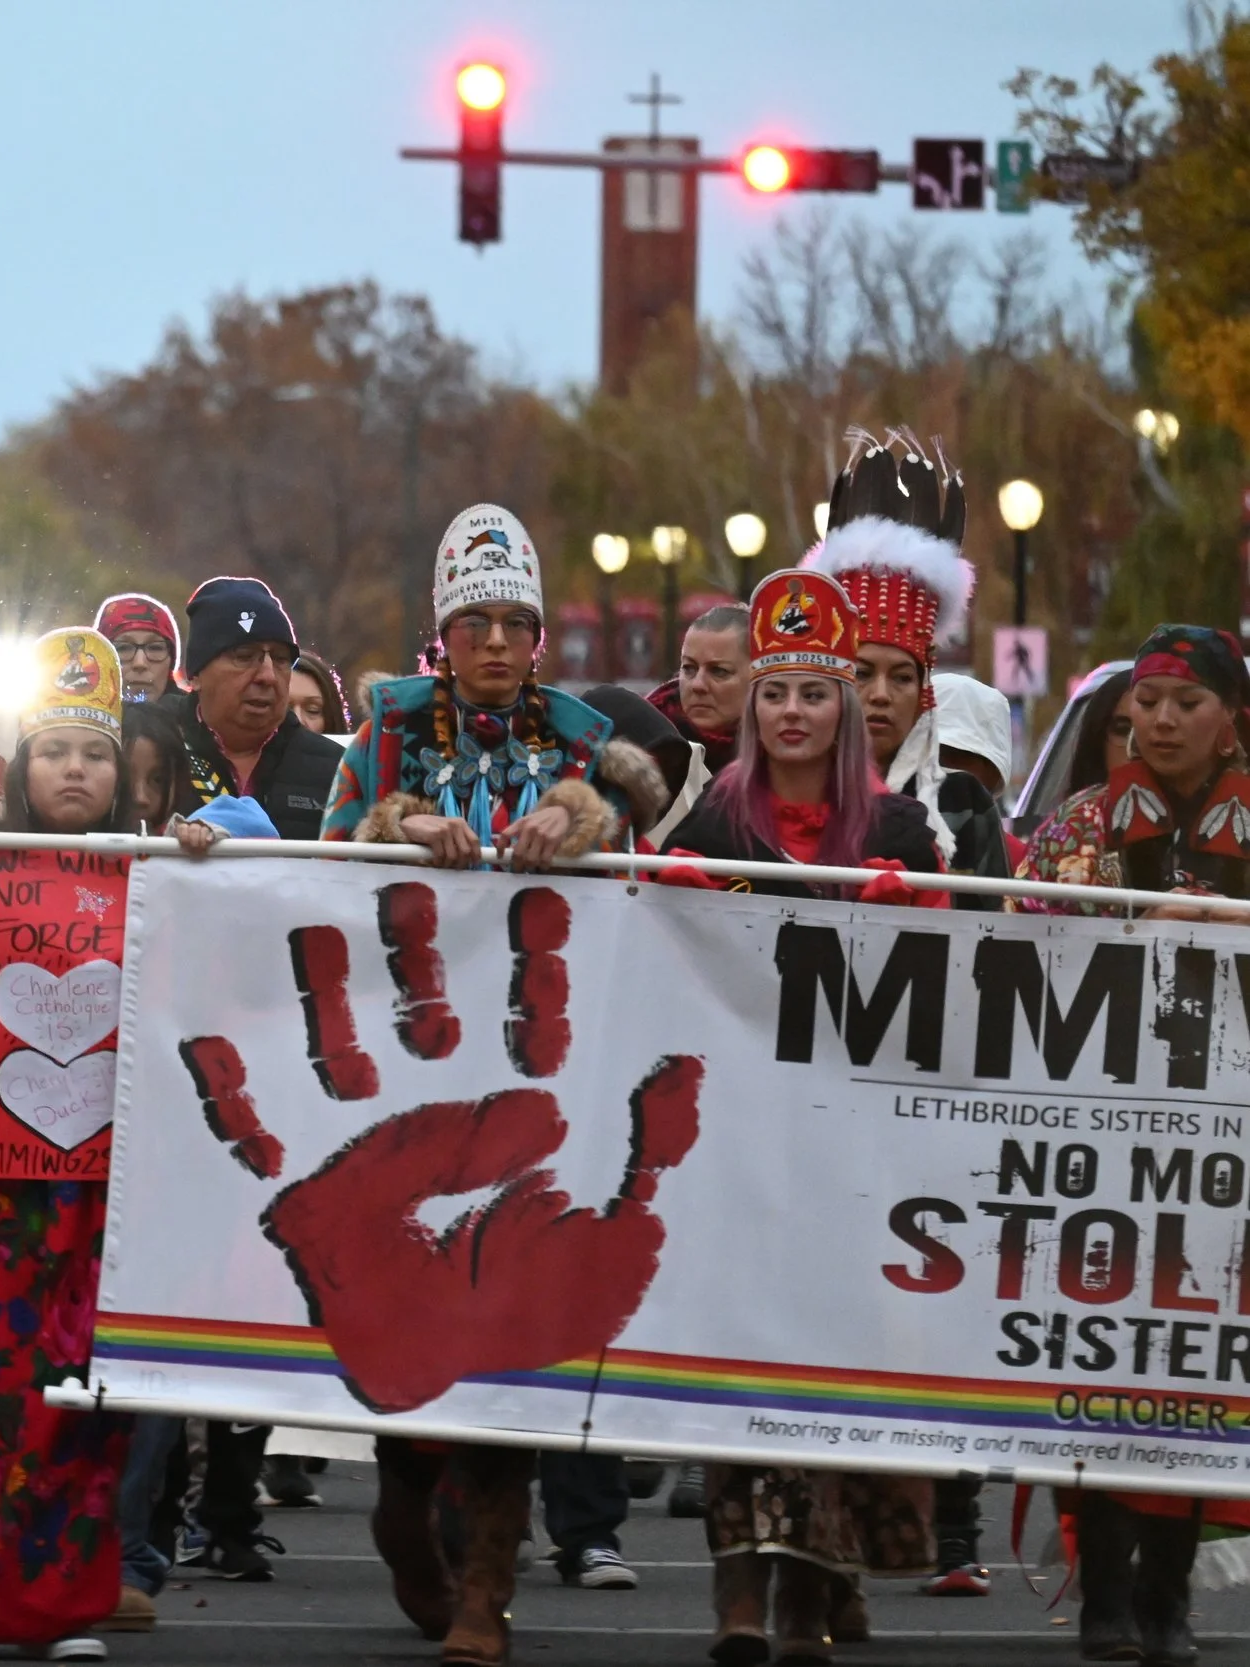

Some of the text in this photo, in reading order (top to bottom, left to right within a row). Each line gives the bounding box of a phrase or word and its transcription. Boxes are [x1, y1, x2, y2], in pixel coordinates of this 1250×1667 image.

[796, 652, 823, 664] 2025
[774, 924, 1250, 1090] MMI
[894, 1095, 1243, 1139] LETHBRIDGE SISTERS IN
[998, 1139, 1250, 1210] NO MO
[881, 1196, 1250, 1317] STOL
[1055, 1390, 1229, 1433] OCTOBER
[748, 1415, 842, 1445] Honoring
[849, 1427, 886, 1445] our
[890, 1427, 966, 1454] missing
[973, 1432, 1014, 1454] and
[1018, 1438, 1119, 1461] murdered
[1126, 1442, 1238, 1470] Indigenous
